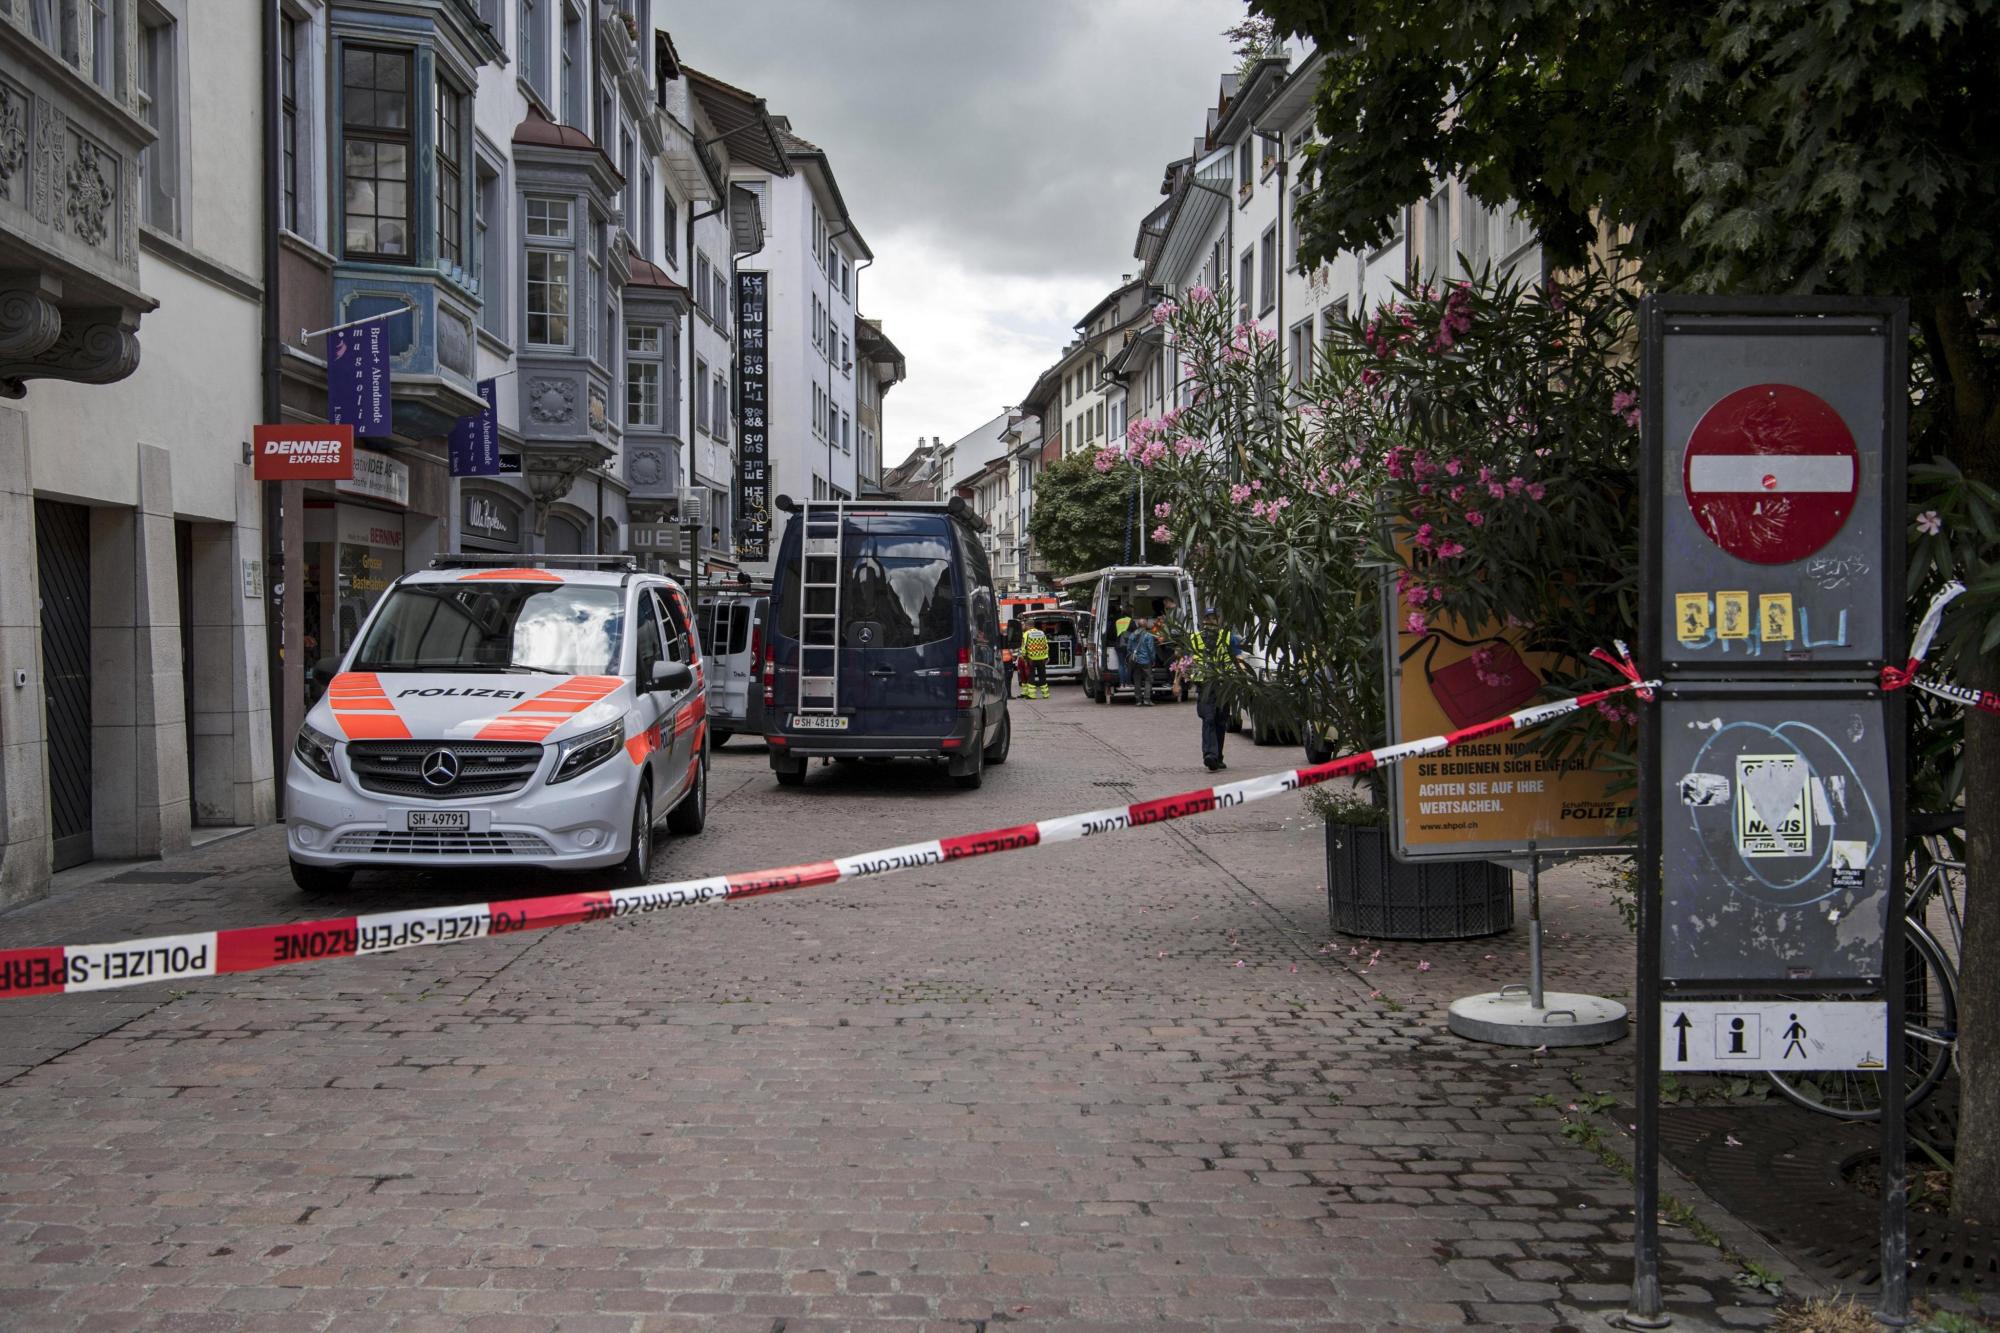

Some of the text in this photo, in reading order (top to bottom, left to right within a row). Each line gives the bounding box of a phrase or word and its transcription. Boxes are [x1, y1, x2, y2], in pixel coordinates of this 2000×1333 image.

[352, 329, 366, 433] magnolia
[371, 367, 383, 424] Abendmode
[264, 440, 342, 455] DENNER
[288, 455, 341, 464] EXPRESS
[634, 529, 673, 547] WE
[396, 687, 526, 699] POLIZEI
[1456, 743, 1501, 757] FRAGEN
[1418, 764, 1437, 777] SIE
[1441, 761, 1499, 776] BEDIENEN
[1503, 759, 1532, 774] SICH
[1419, 780, 1544, 797] ACHTEN SIE AUF IHRE
[1419, 799, 1505, 815] WERTSACHEN.
[1420, 821, 1479, 831] www.shpol.ch
[273, 908, 527, 963] POLIZEI-SPERRZONE
